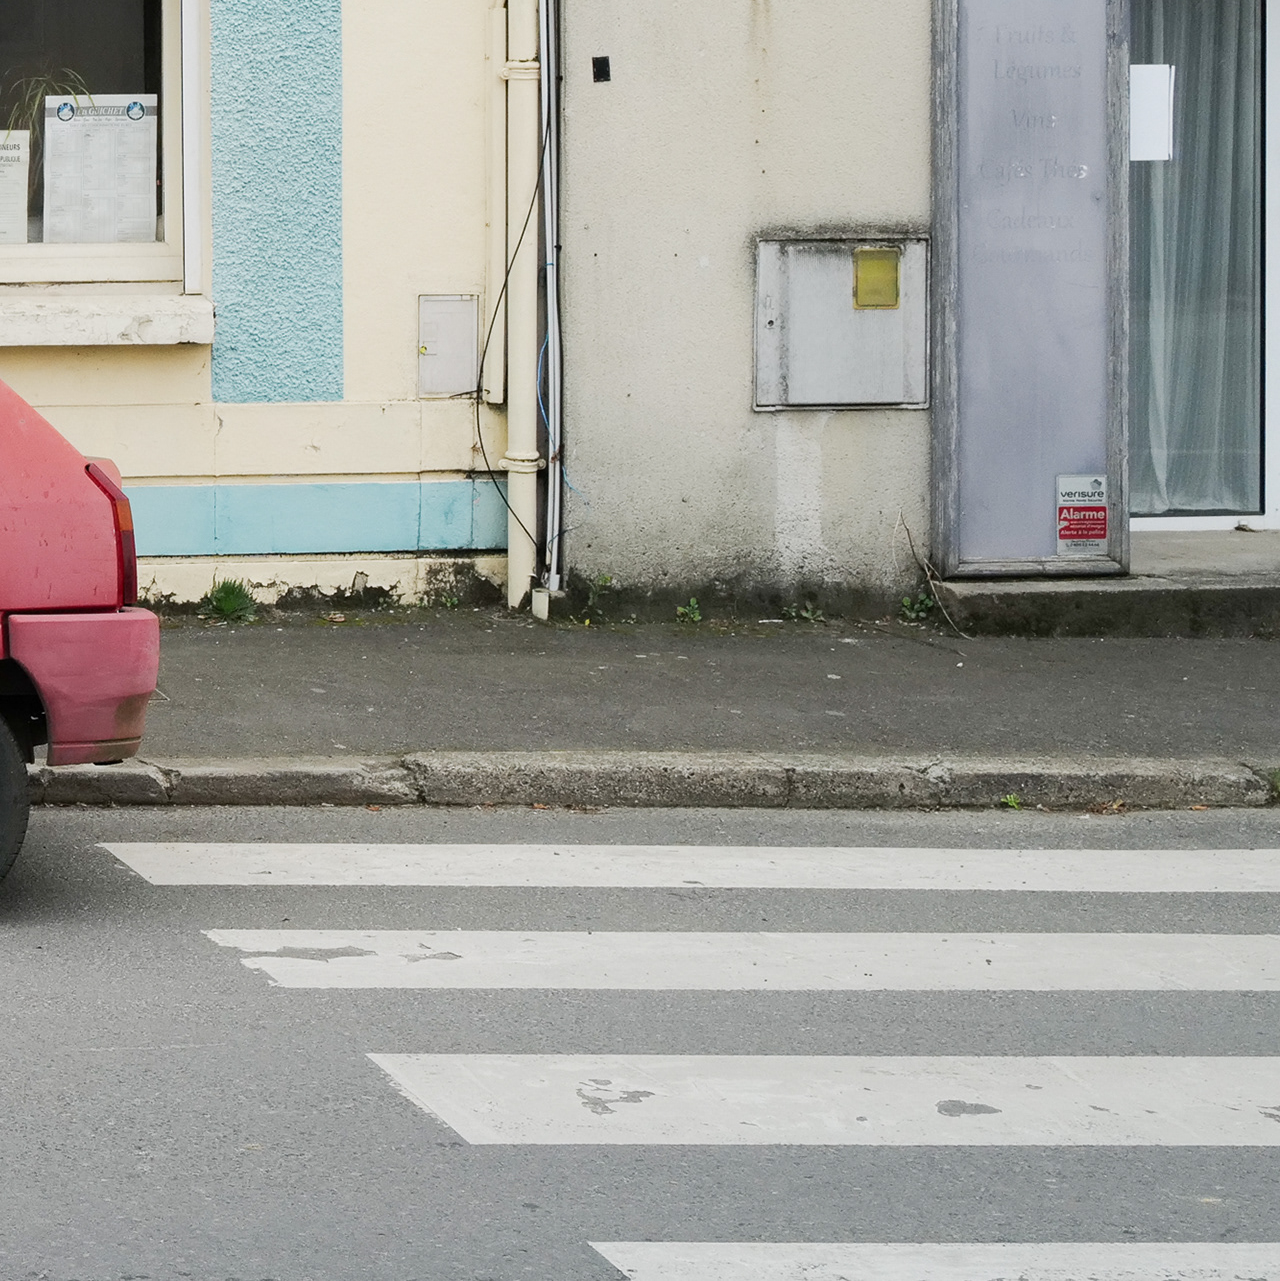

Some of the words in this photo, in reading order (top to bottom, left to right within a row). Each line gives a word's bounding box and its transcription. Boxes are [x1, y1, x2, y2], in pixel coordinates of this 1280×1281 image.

[995, 24, 1055, 46] Fruits
[1060, 490, 1105, 498] verisure
[1060, 508, 1106, 520] Alarme
